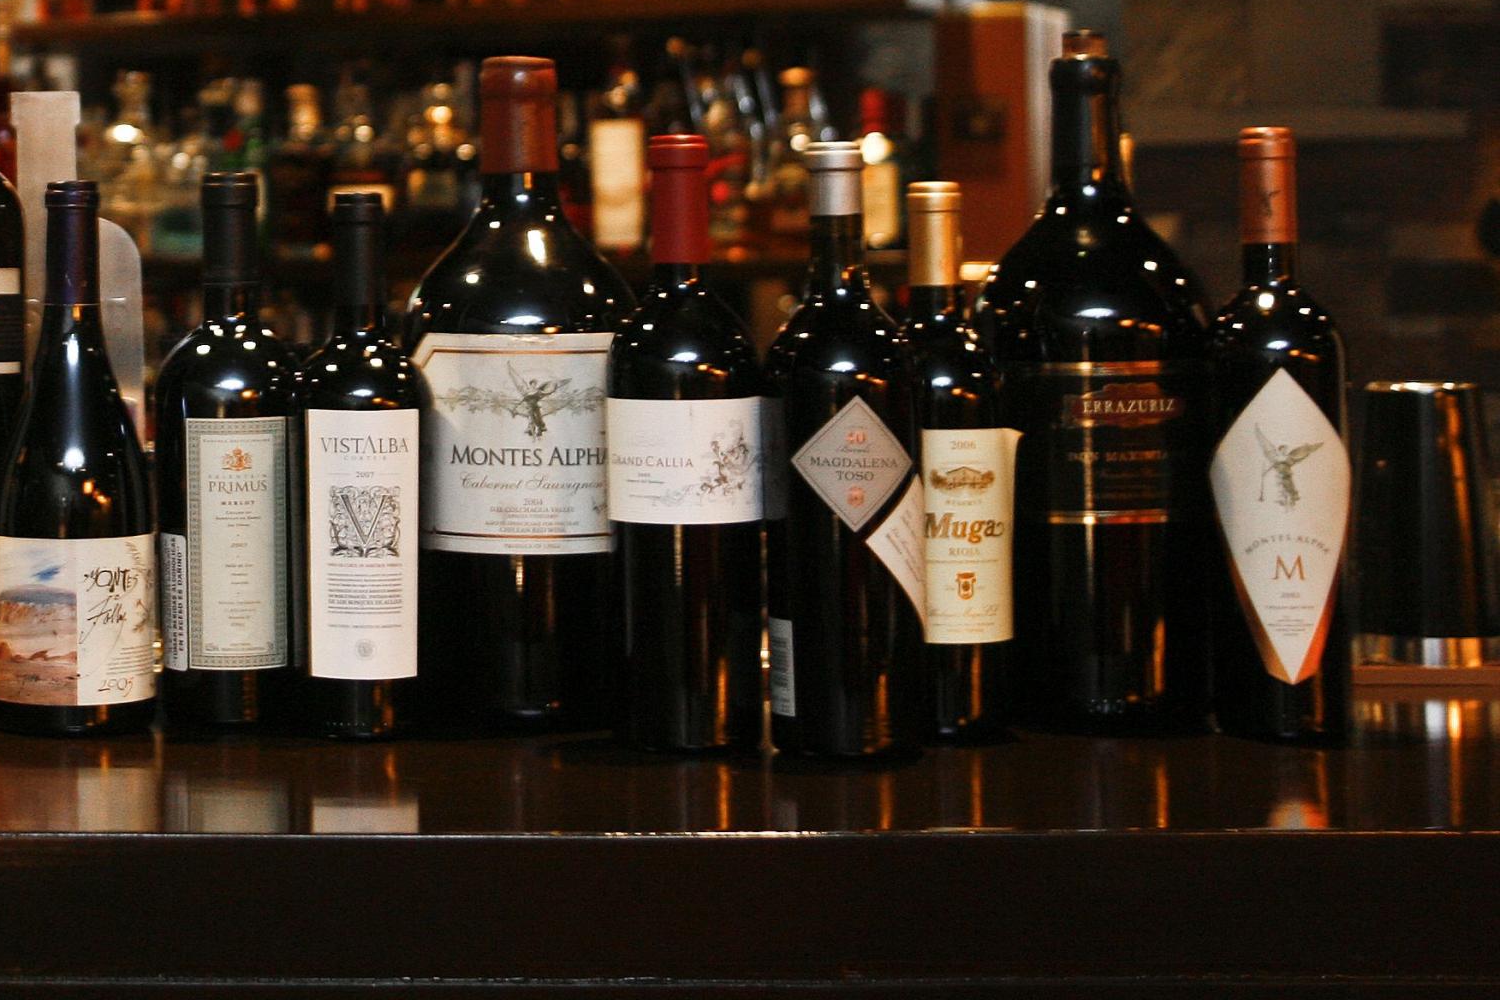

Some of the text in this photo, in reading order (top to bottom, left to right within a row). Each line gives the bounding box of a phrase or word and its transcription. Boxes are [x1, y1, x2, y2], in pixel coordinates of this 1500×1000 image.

[1083, 398, 1175, 413] ERRAZURIZ
[320, 435, 409, 454] VISTALBA
[450, 445, 542, 467] MONTES
[645, 456, 694, 468] CALLIA
[810, 456, 898, 468] MAGDALENA
[460, 471, 523, 490] Cabernet
[835, 470, 874, 481] TOSO
[208, 480, 268, 494] PRIMUS
[924, 512, 1005, 544] Muga
[1272, 554, 1306, 581] M
